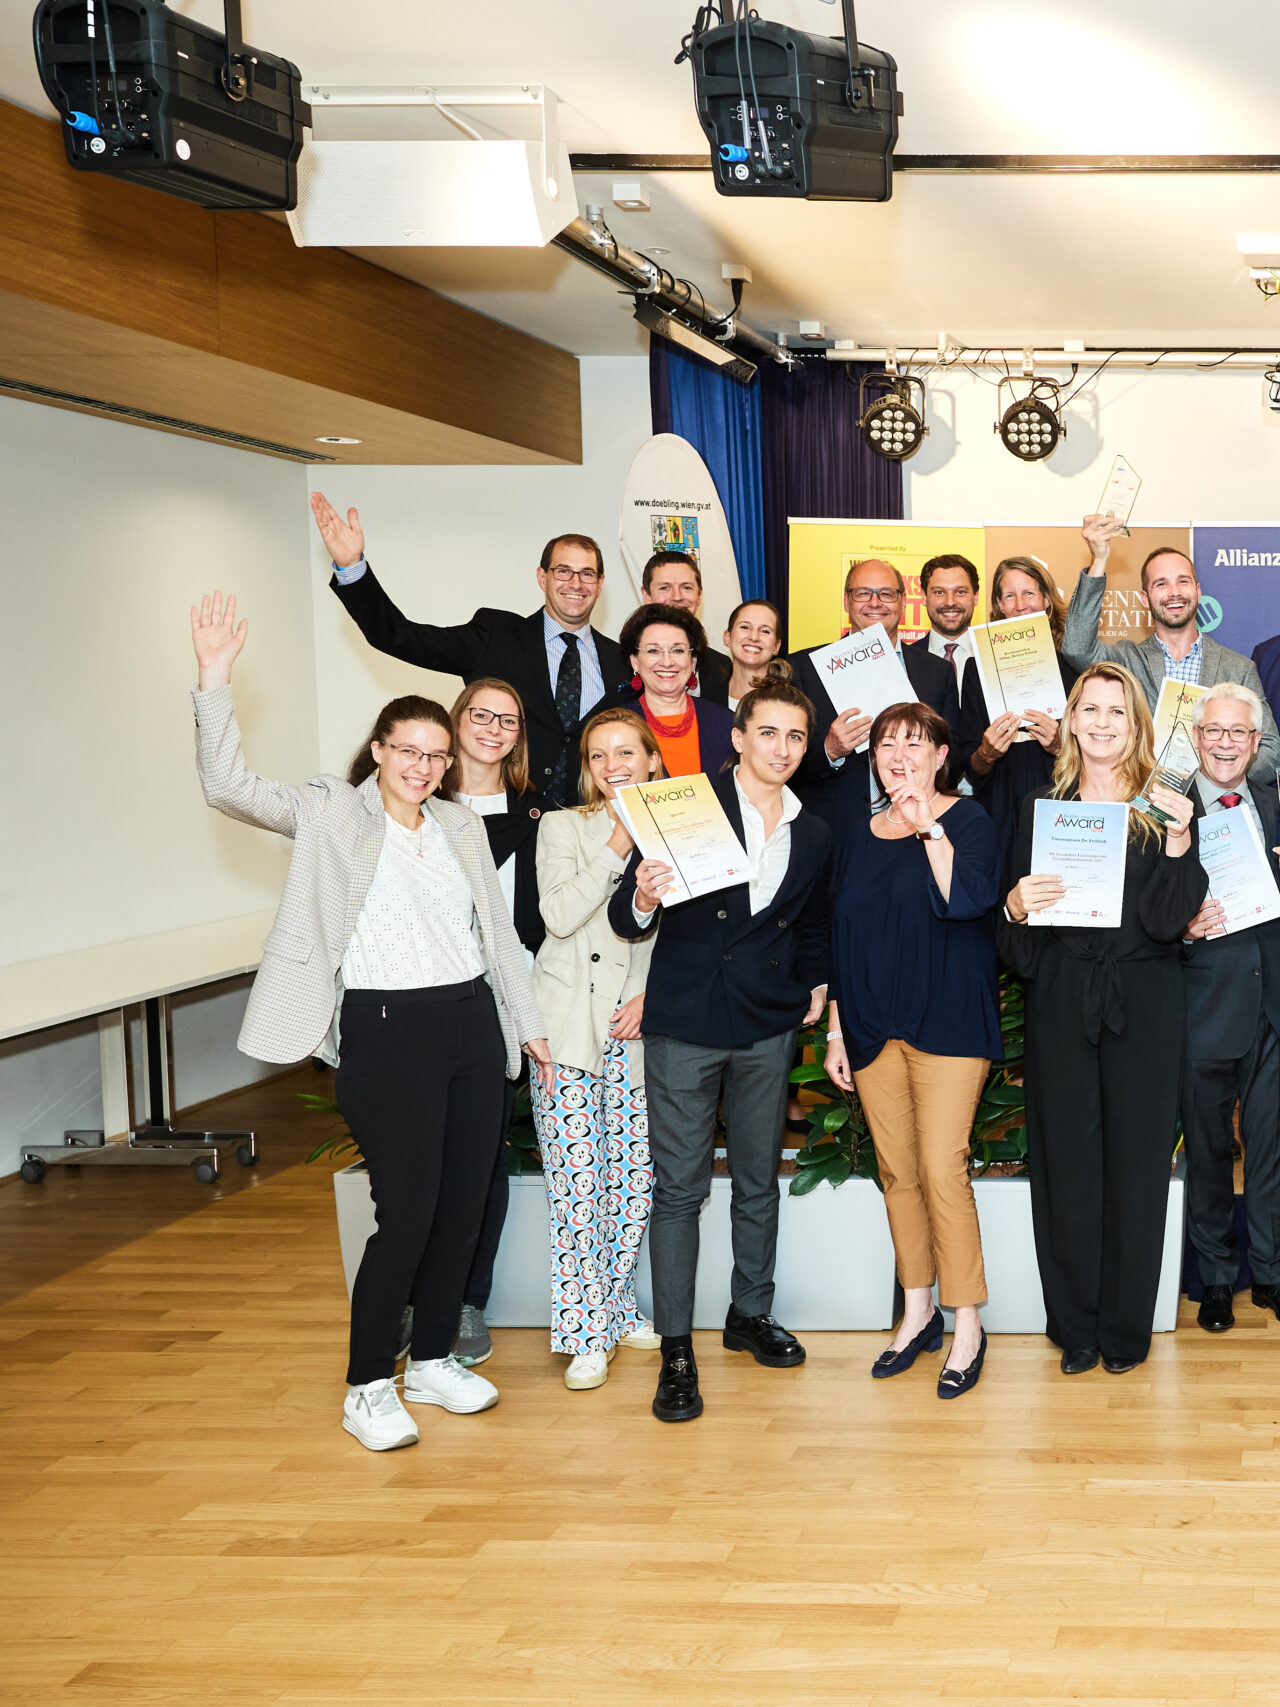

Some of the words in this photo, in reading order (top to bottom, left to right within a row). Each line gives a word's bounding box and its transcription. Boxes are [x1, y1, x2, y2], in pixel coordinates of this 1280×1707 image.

[634, 499, 711, 511] www.doebling.wien.gv.at
[992, 626, 1036, 645] Award
[831, 638, 885, 675] Award
[644, 785, 696, 804] Award
[1054, 813, 1105, 830] Award
